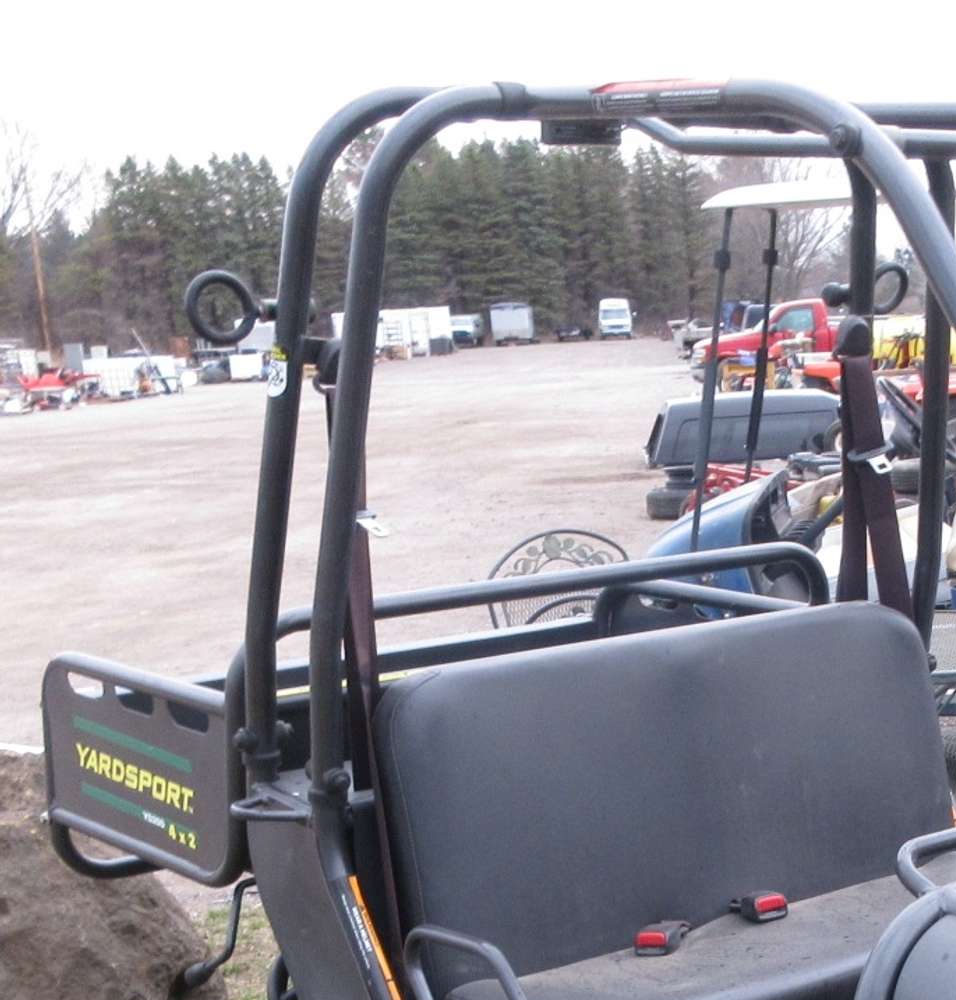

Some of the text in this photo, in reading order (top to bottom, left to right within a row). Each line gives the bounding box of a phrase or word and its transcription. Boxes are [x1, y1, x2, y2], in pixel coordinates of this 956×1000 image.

[76, 742, 194, 812] YARDSPORT
[168, 824, 176, 840] 4
[188, 832, 197, 849] 2
